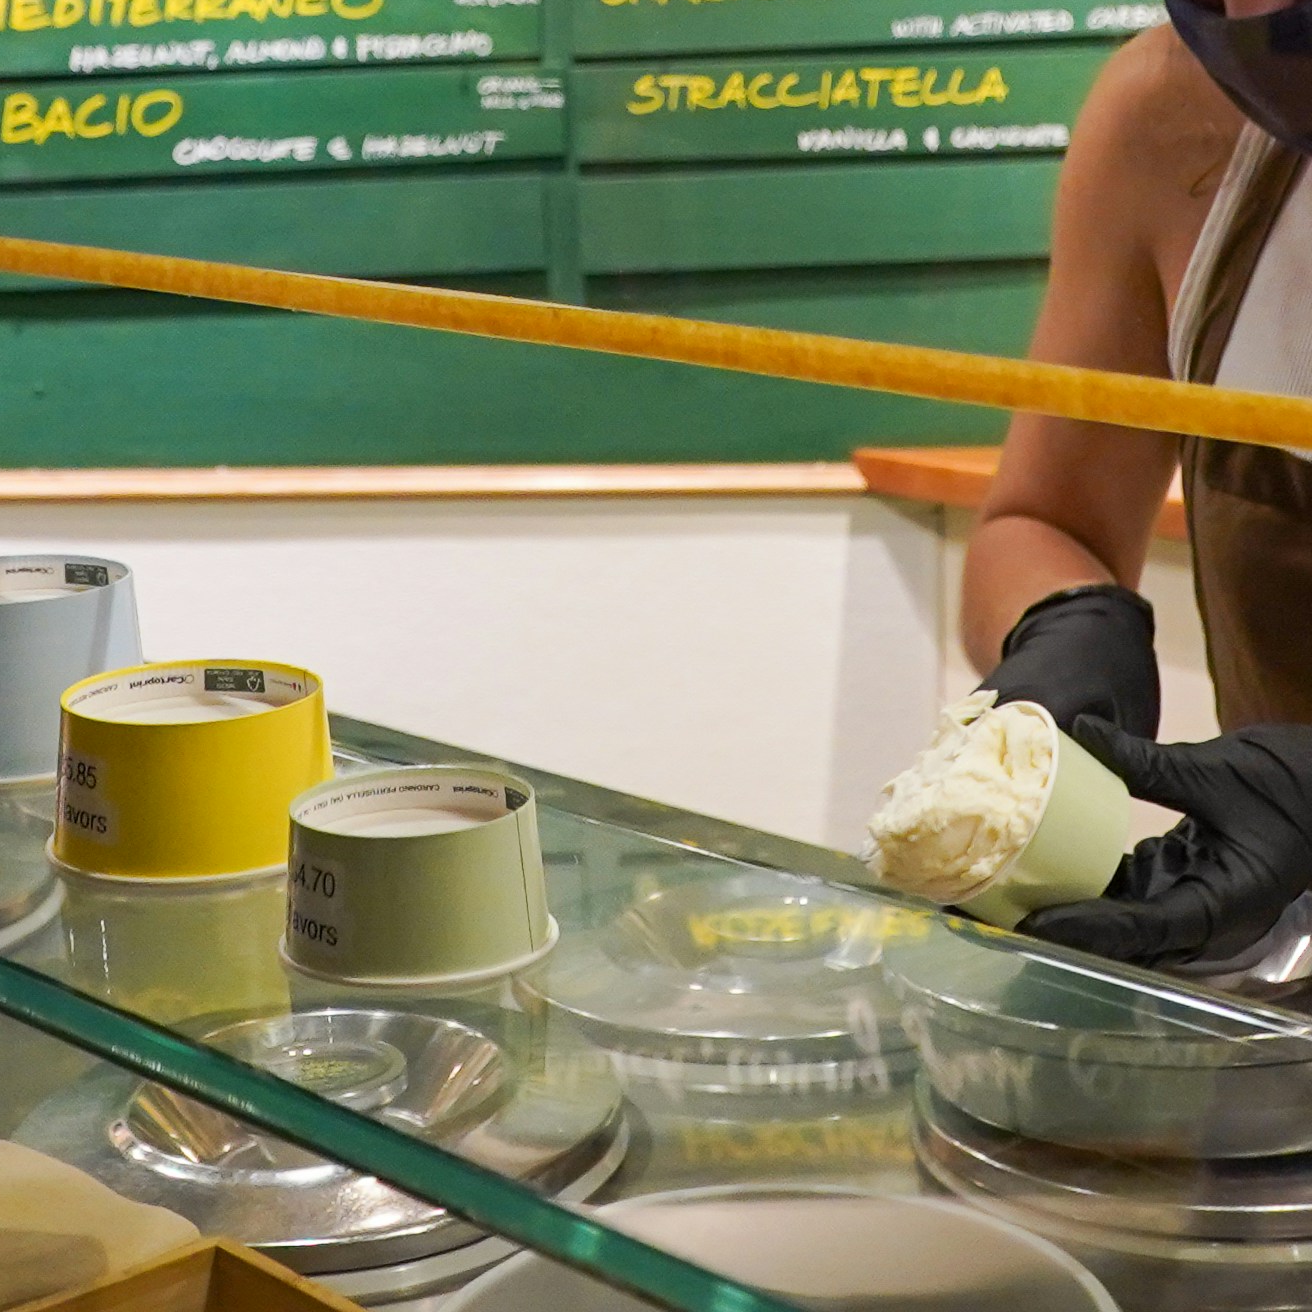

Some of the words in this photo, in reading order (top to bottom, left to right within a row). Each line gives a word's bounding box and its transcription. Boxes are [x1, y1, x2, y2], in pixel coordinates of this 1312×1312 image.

[0, 87, 184, 145] BACIO
[626, 65, 1009, 116] STRACCIATELLA
[128, 673, 186, 690] Cartoprint
